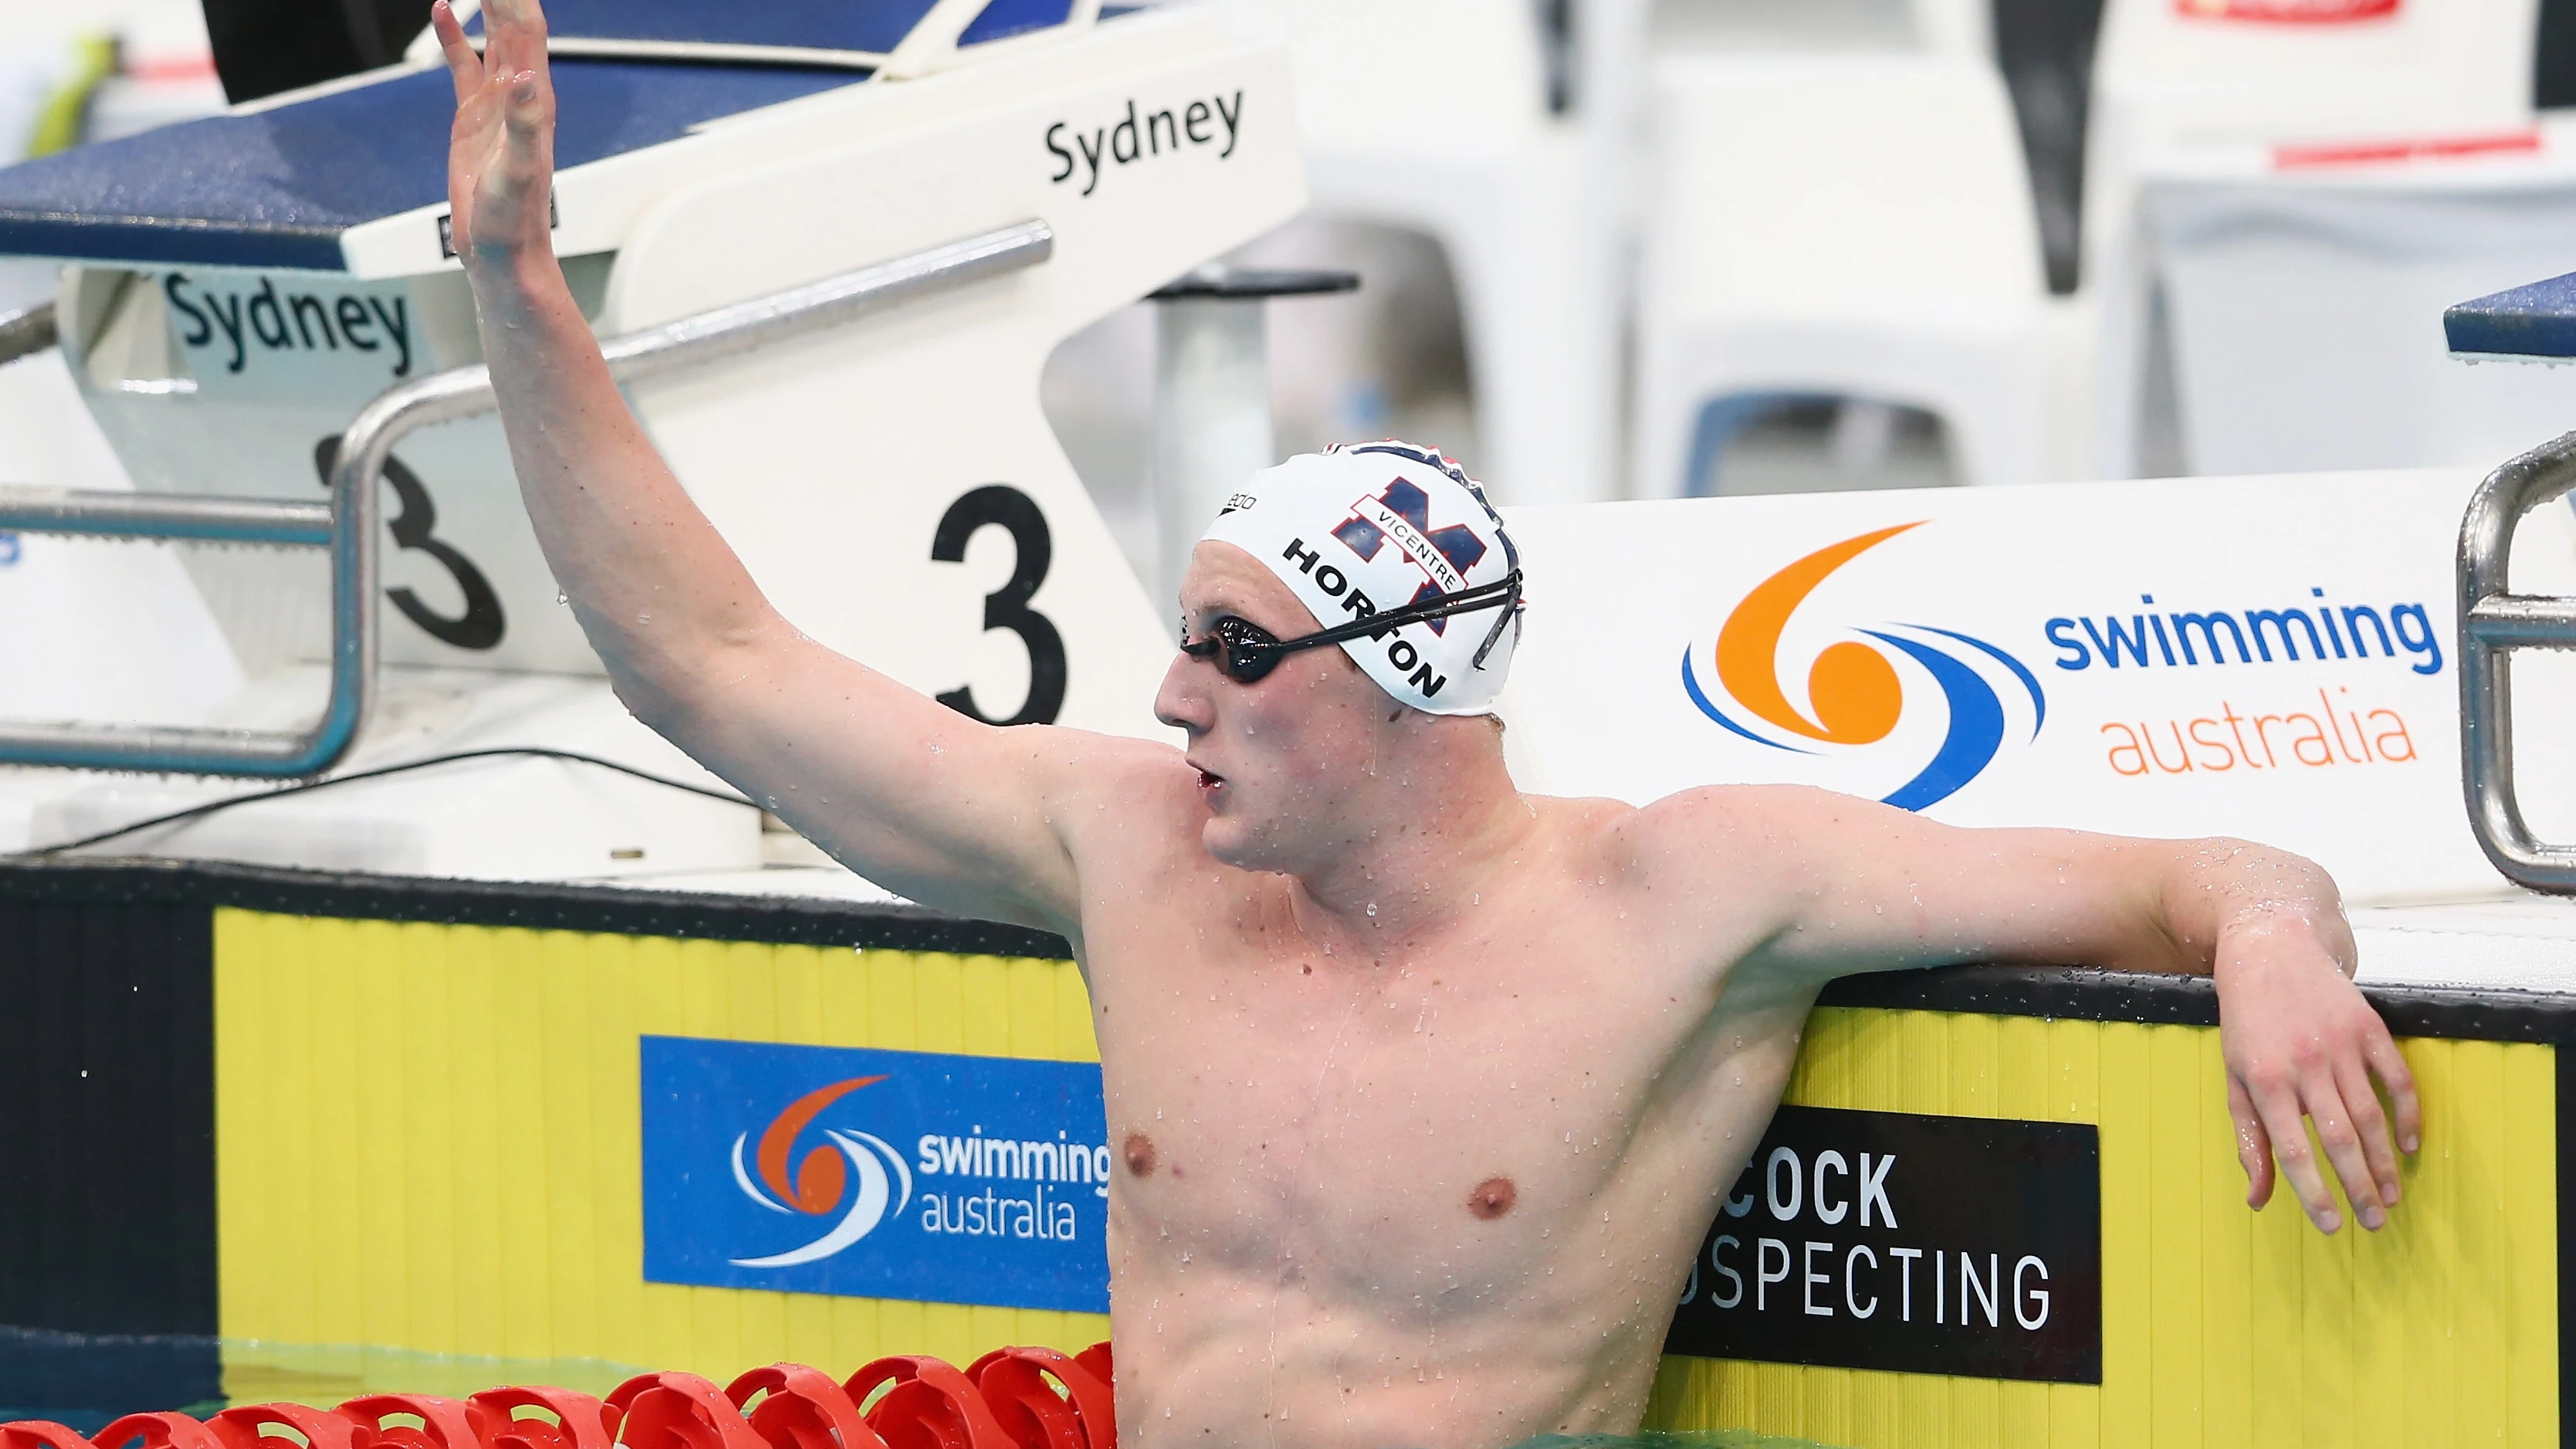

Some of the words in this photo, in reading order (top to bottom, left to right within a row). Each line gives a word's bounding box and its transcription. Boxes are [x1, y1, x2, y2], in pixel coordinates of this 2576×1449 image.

[1045, 90, 1244, 197] Sydney
[163, 271, 412, 376] Sydney
[314, 433, 507, 651] 3
[1227, 491, 1257, 510] edo
[1379, 510, 1457, 591] VICENTRE
[931, 483, 1068, 726] 3
[2045, 587, 2443, 675] swimming
[2100, 686, 2418, 776] australia
[917, 1124, 1110, 1197] swimming
[921, 1184, 1075, 1241] australia
[1677, 1234, 2050, 1331] SPECTING
